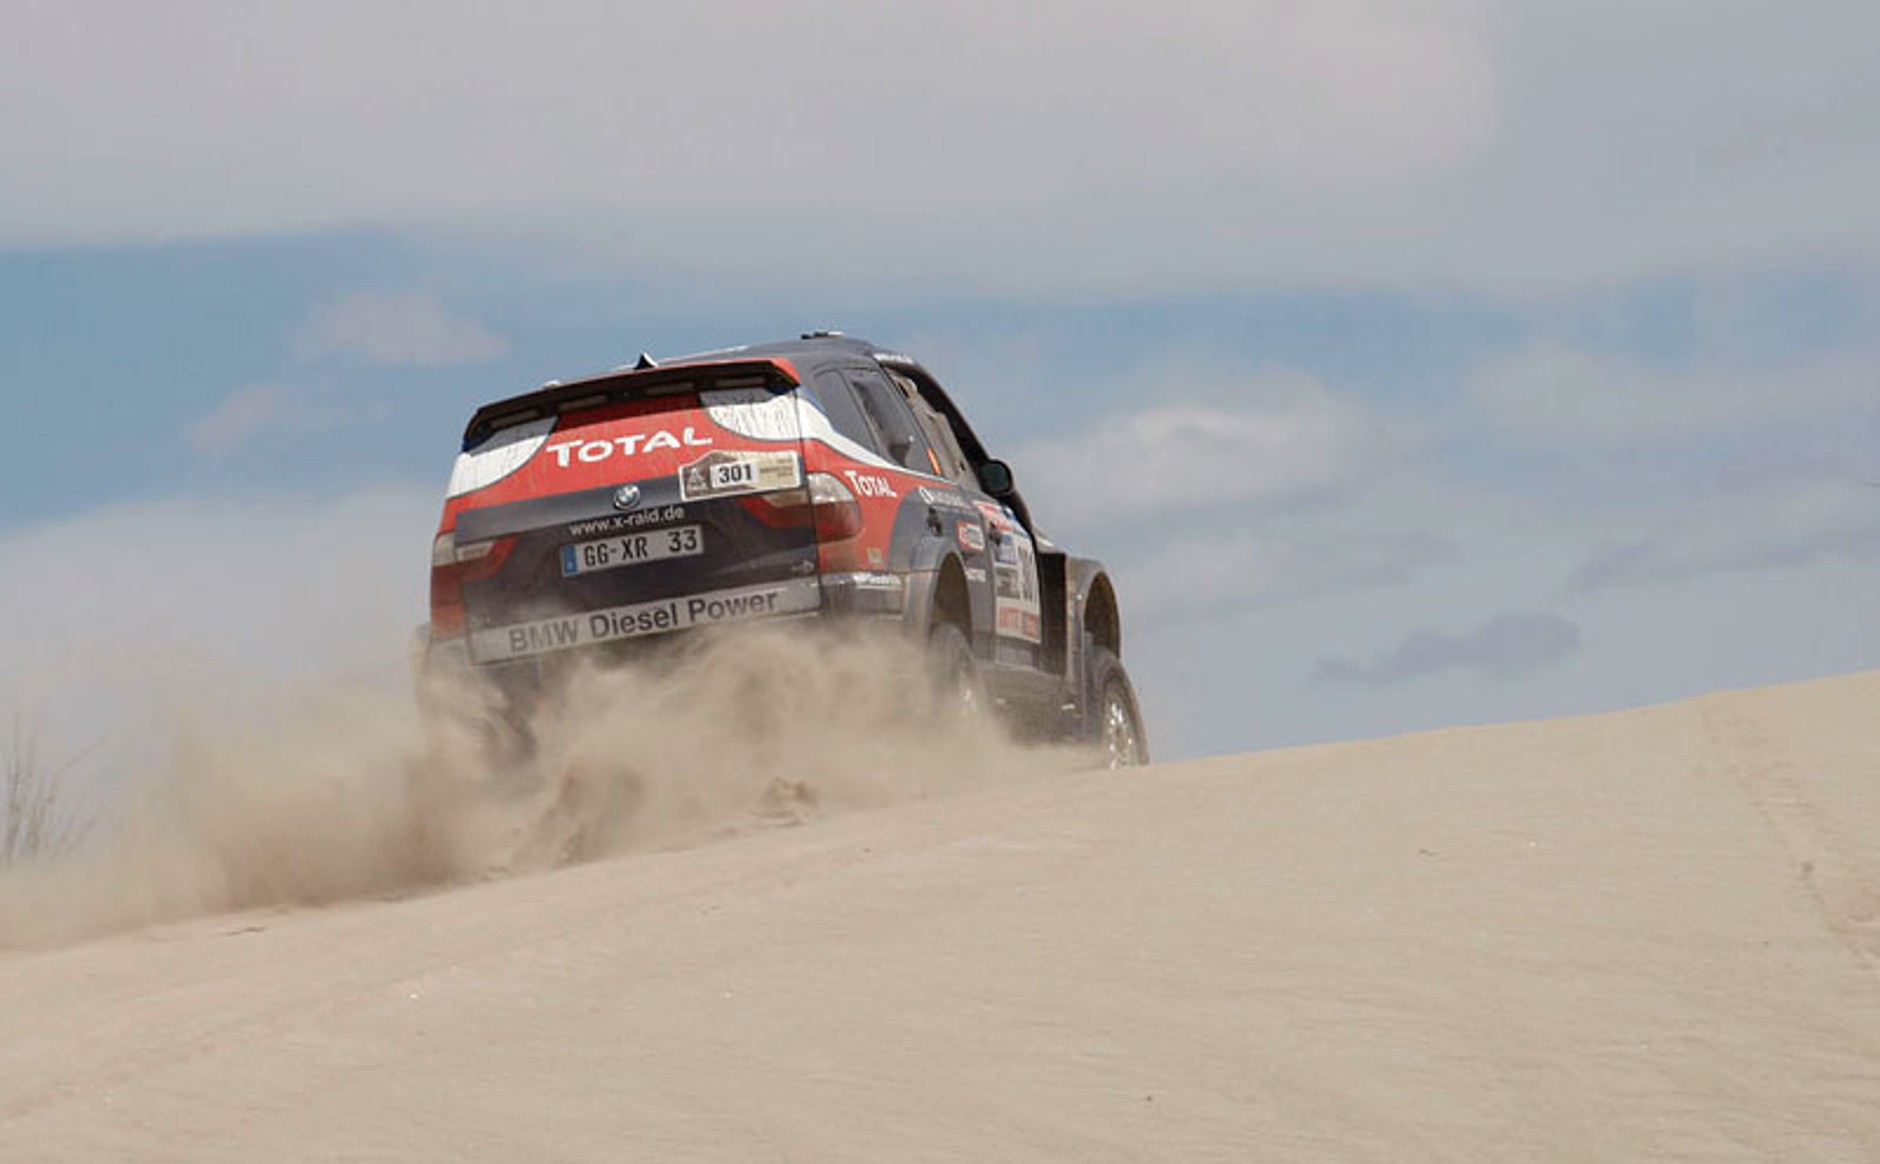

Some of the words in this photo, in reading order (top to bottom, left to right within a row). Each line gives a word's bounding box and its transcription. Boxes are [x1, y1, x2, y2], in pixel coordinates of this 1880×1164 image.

[546, 427, 713, 467] TOTAL
[718, 463, 752, 483] 301
[843, 470, 897, 497] TOTAL
[569, 504, 685, 536] www.x-raid.de
[668, 529, 698, 552] 33
[509, 620, 581, 653] BMW
[590, 601, 679, 638] Diesel
[688, 591, 778, 622] Power
